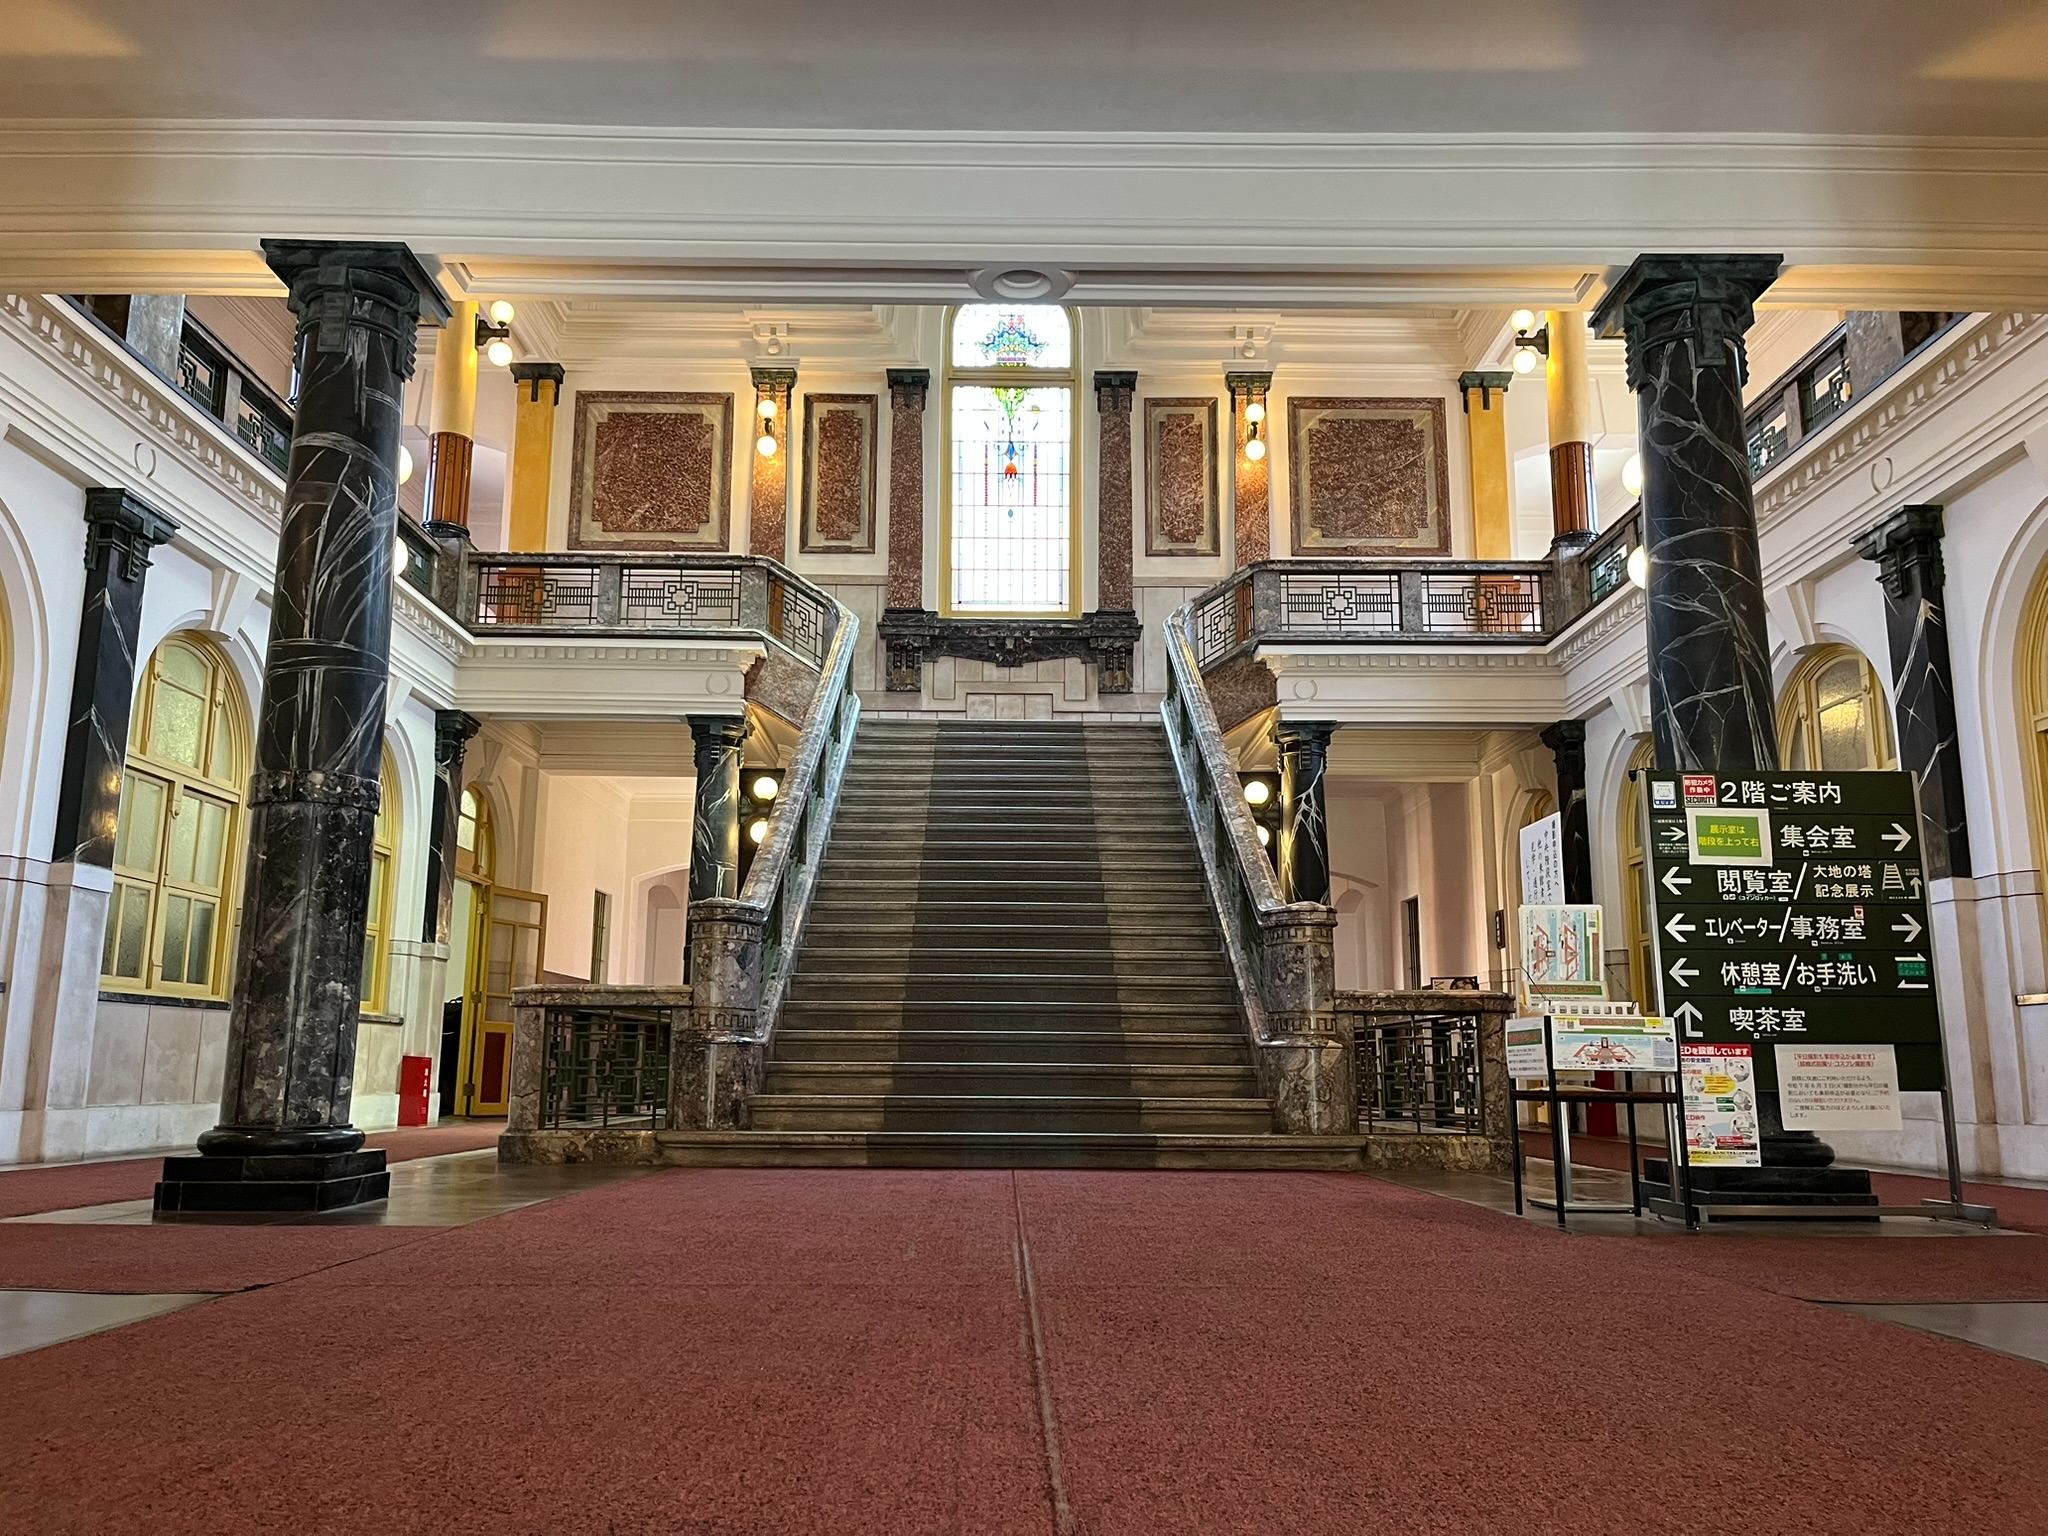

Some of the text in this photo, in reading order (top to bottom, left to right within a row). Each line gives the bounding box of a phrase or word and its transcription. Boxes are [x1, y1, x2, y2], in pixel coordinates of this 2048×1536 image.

[1720, 780, 1842, 805] 2階ご案内
[1685, 796, 1715, 804] SECURITY
[1710, 825, 1745, 834] 展示室は
[1780, 825, 1857, 848] 集会室
[1698, 836, 1760, 847] 階段を上って右
[1813, 865, 1873, 879] 大地の塔
[1814, 883, 1875, 898] 記念展示
[1729, 1007, 1808, 1032] 喫茶室
